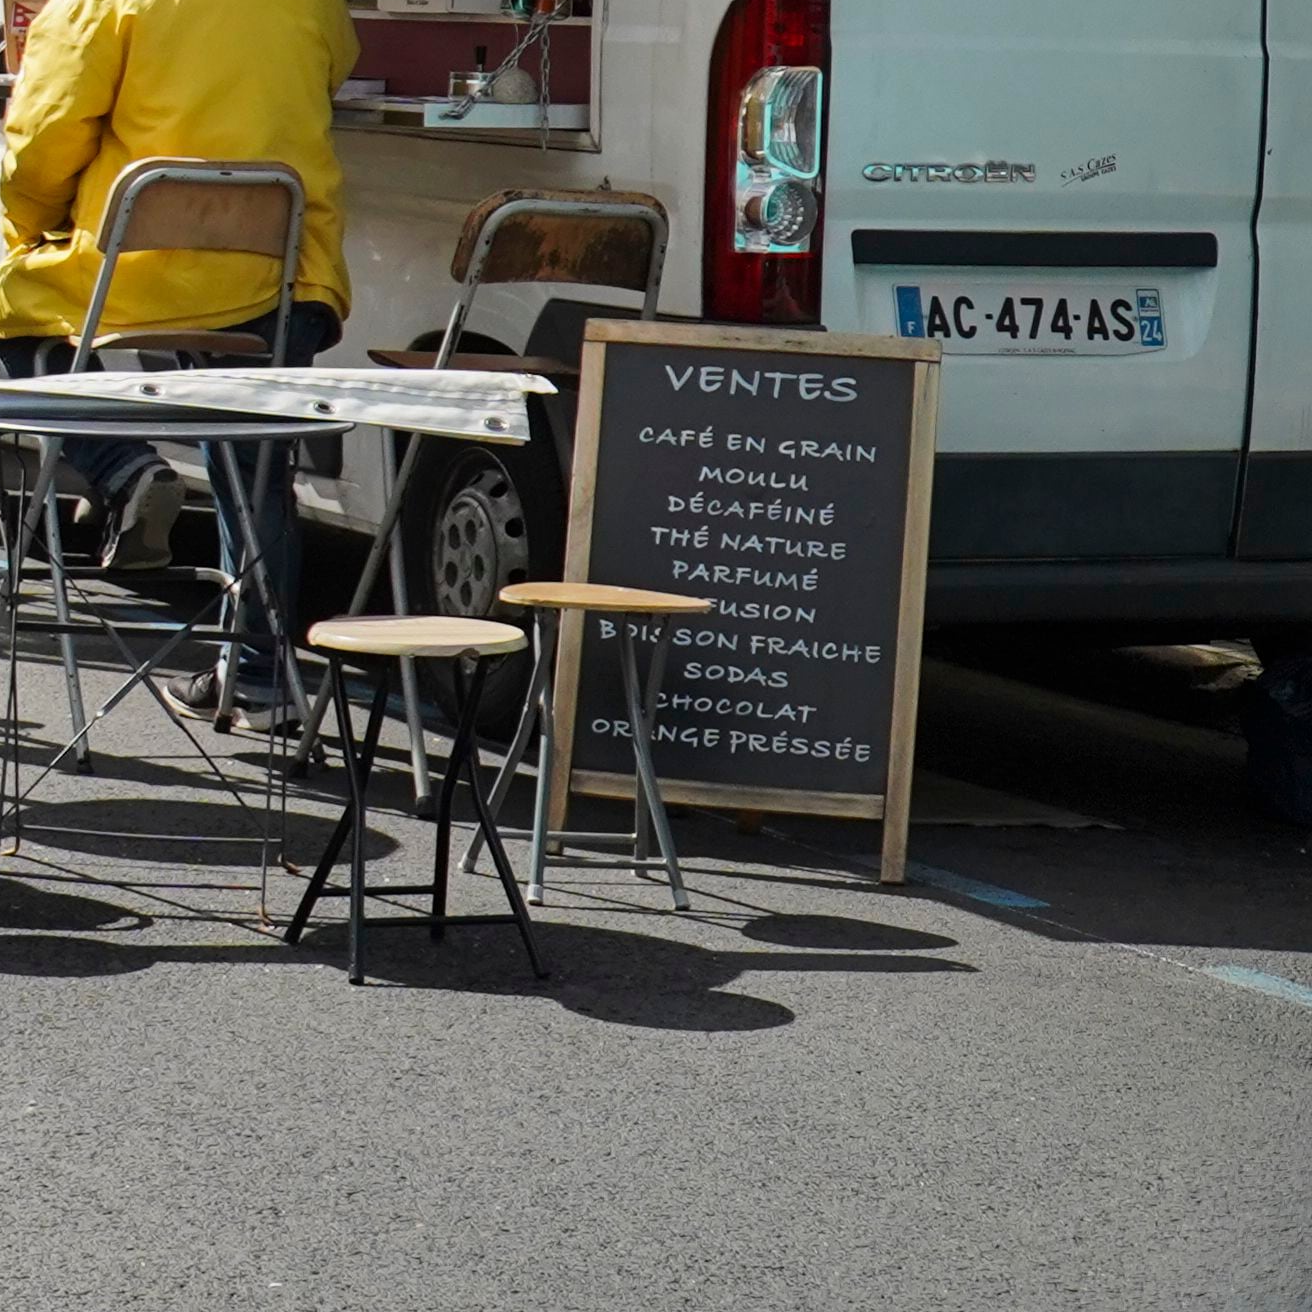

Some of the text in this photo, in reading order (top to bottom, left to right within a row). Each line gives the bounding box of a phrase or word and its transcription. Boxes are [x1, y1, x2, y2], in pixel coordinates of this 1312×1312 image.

[862, 160, 1036, 183] CITROËN
[906, 320, 916, 334] F
[927, 295, 1135, 342] AC-474-AS
[1140, 319, 1163, 341] 24
[665, 364, 858, 402] VENTES
[639, 426, 877, 464] CAFÉ EN GRAIN
[698, 465, 808, 492] MOULU
[668, 492, 835, 526] DÉCAFÉINÉ
[650, 525, 848, 561] THÉ NATURE
[672, 559, 819, 592] PARFUMÉ
[703, 597, 816, 623] FUSION
[750, 635, 881, 664] FRAICHE
[683, 662, 789, 689] SODAS
[656, 692, 817, 724] CHOCOLAT
[591, 718, 871, 763] ORNGE PRÉSSÉE
